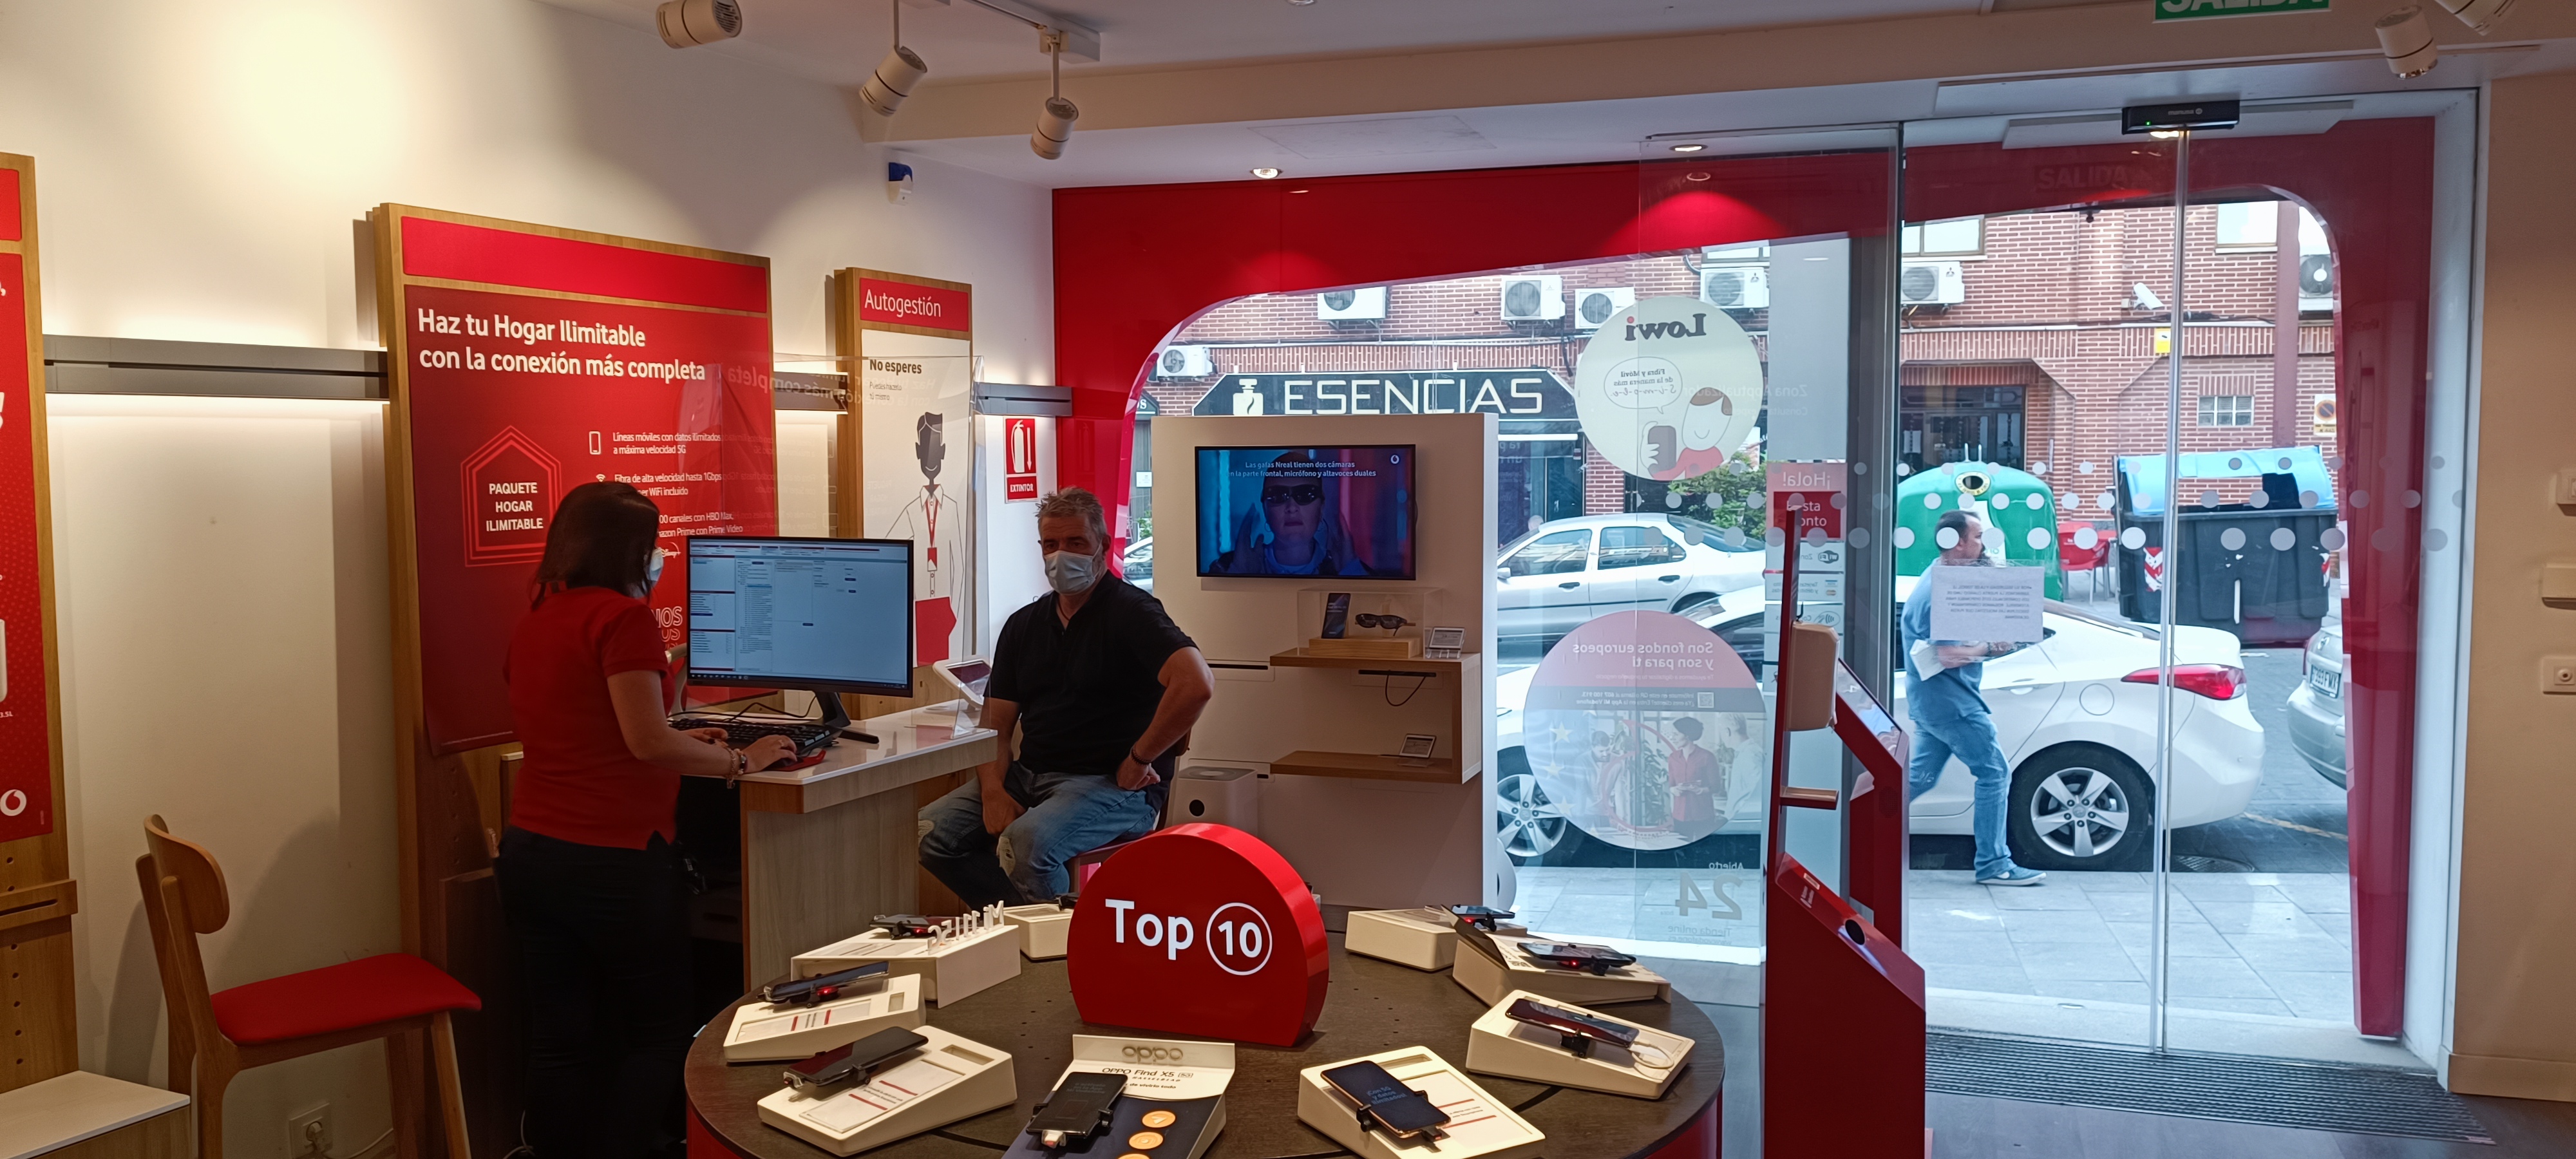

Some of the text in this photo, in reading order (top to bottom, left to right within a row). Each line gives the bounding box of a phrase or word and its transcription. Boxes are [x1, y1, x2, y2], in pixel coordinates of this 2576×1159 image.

[864, 288, 941, 317] Autogestión
[418, 308, 646, 347] Haz tu Hogar Ilimitable
[419, 347, 706, 384] con la conexión más completa
[869, 359, 922, 375] No esperes
[1284, 377, 1542, 415] ESENCIAS
[612, 432, 634, 442] Líneas
[635, 432, 660, 442] móviles
[674, 433, 692, 441] datos
[692, 433, 721, 441] ilimitados
[619, 445, 645, 455] máxima
[645, 445, 676, 454] velocidad
[677, 444, 686, 454] 5G
[1257, 462, 1274, 470] gafas
[1328, 460, 1356, 468] cámaras
[614, 472, 722, 483] Fibra de alta velocidad hasta 1Gbps
[489, 482, 538, 495] PAQUETE
[649, 487, 663, 496] WiFi
[663, 487, 689, 496] incluido
[1010, 483, 1034, 493] EXTINTOR
[495, 500, 533, 513] HOGAR
[486, 517, 544, 532] ILIMITABLE
[658, 514, 668, 524] 00
[669, 513, 693, 523] canales
[693, 513, 706, 522] con
[706, 512, 719, 521] HBO
[676, 528, 695, 537] Prime
[696, 527, 708, 536] con
[708, 525, 726, 535] Prime
[726, 524, 744, 533] Video
[1105, 898, 1195, 961] Top
[1217, 920, 1263, 958] 10
